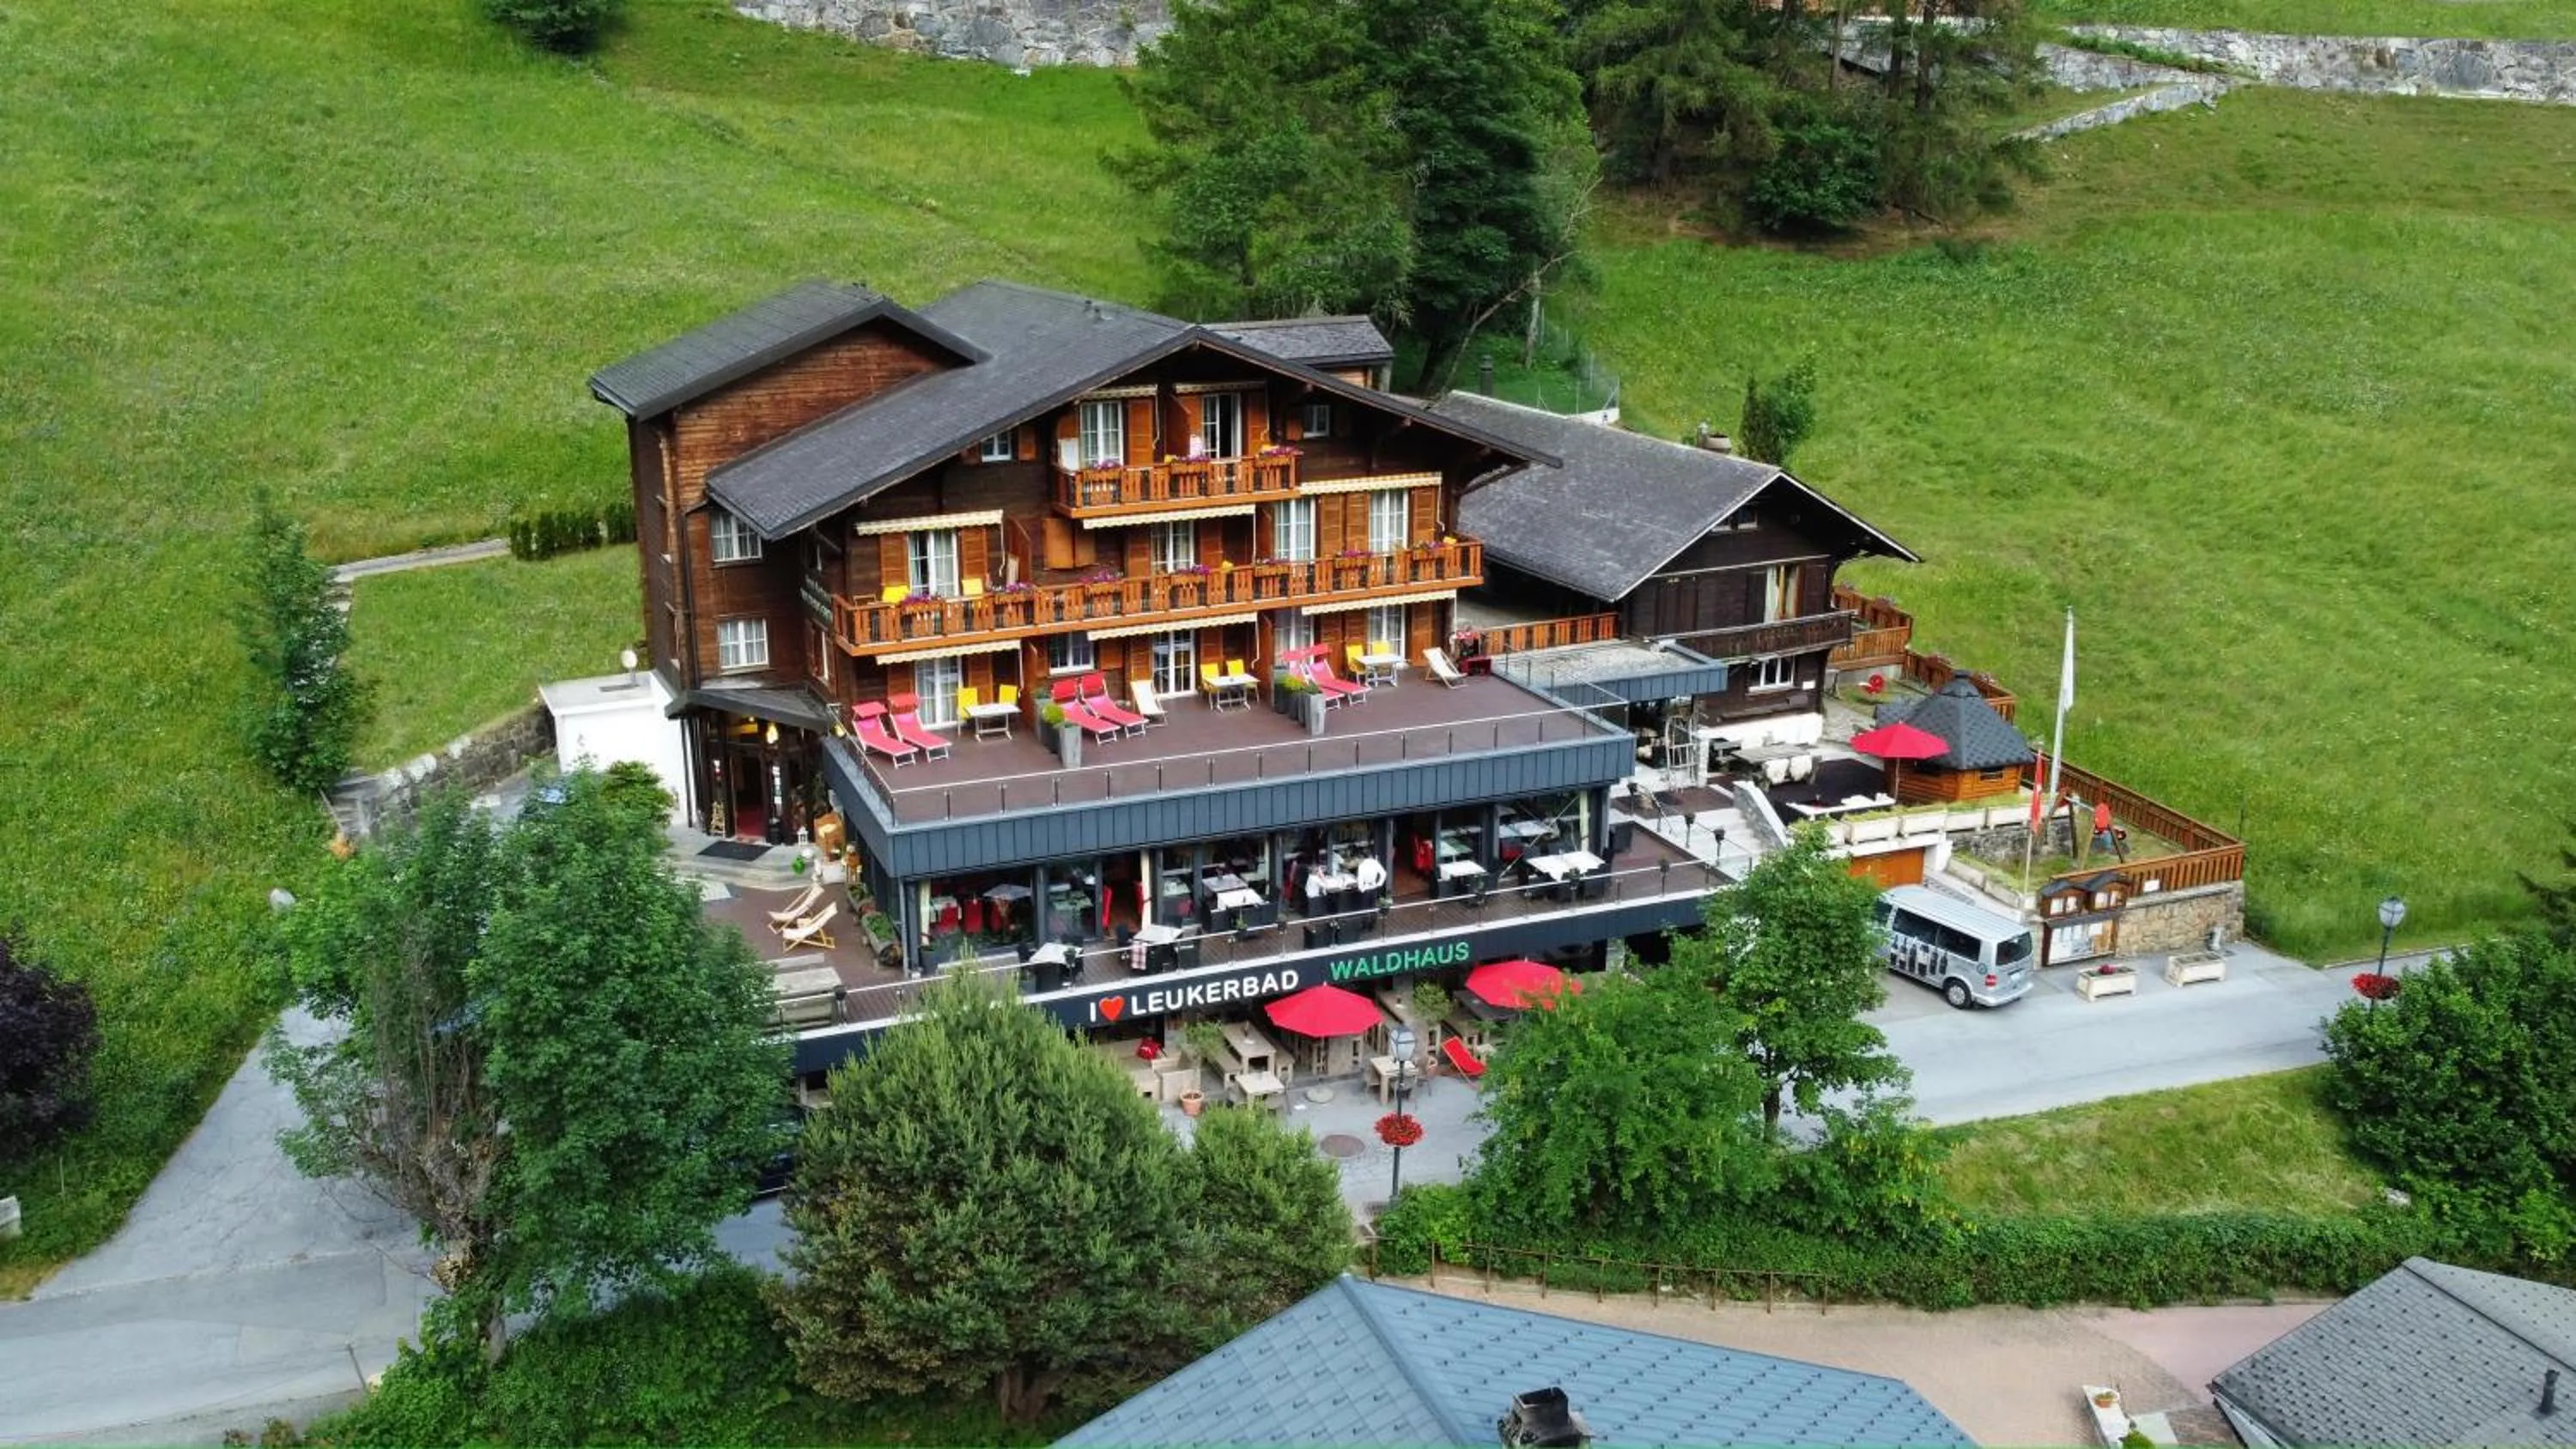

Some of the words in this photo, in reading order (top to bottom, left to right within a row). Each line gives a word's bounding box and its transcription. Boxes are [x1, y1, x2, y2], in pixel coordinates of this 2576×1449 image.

[1330, 942, 1469, 980] WALDHAUS
[1090, 1002, 1097, 1022] I
[1131, 970, 1298, 1015] LEUKERBAD
